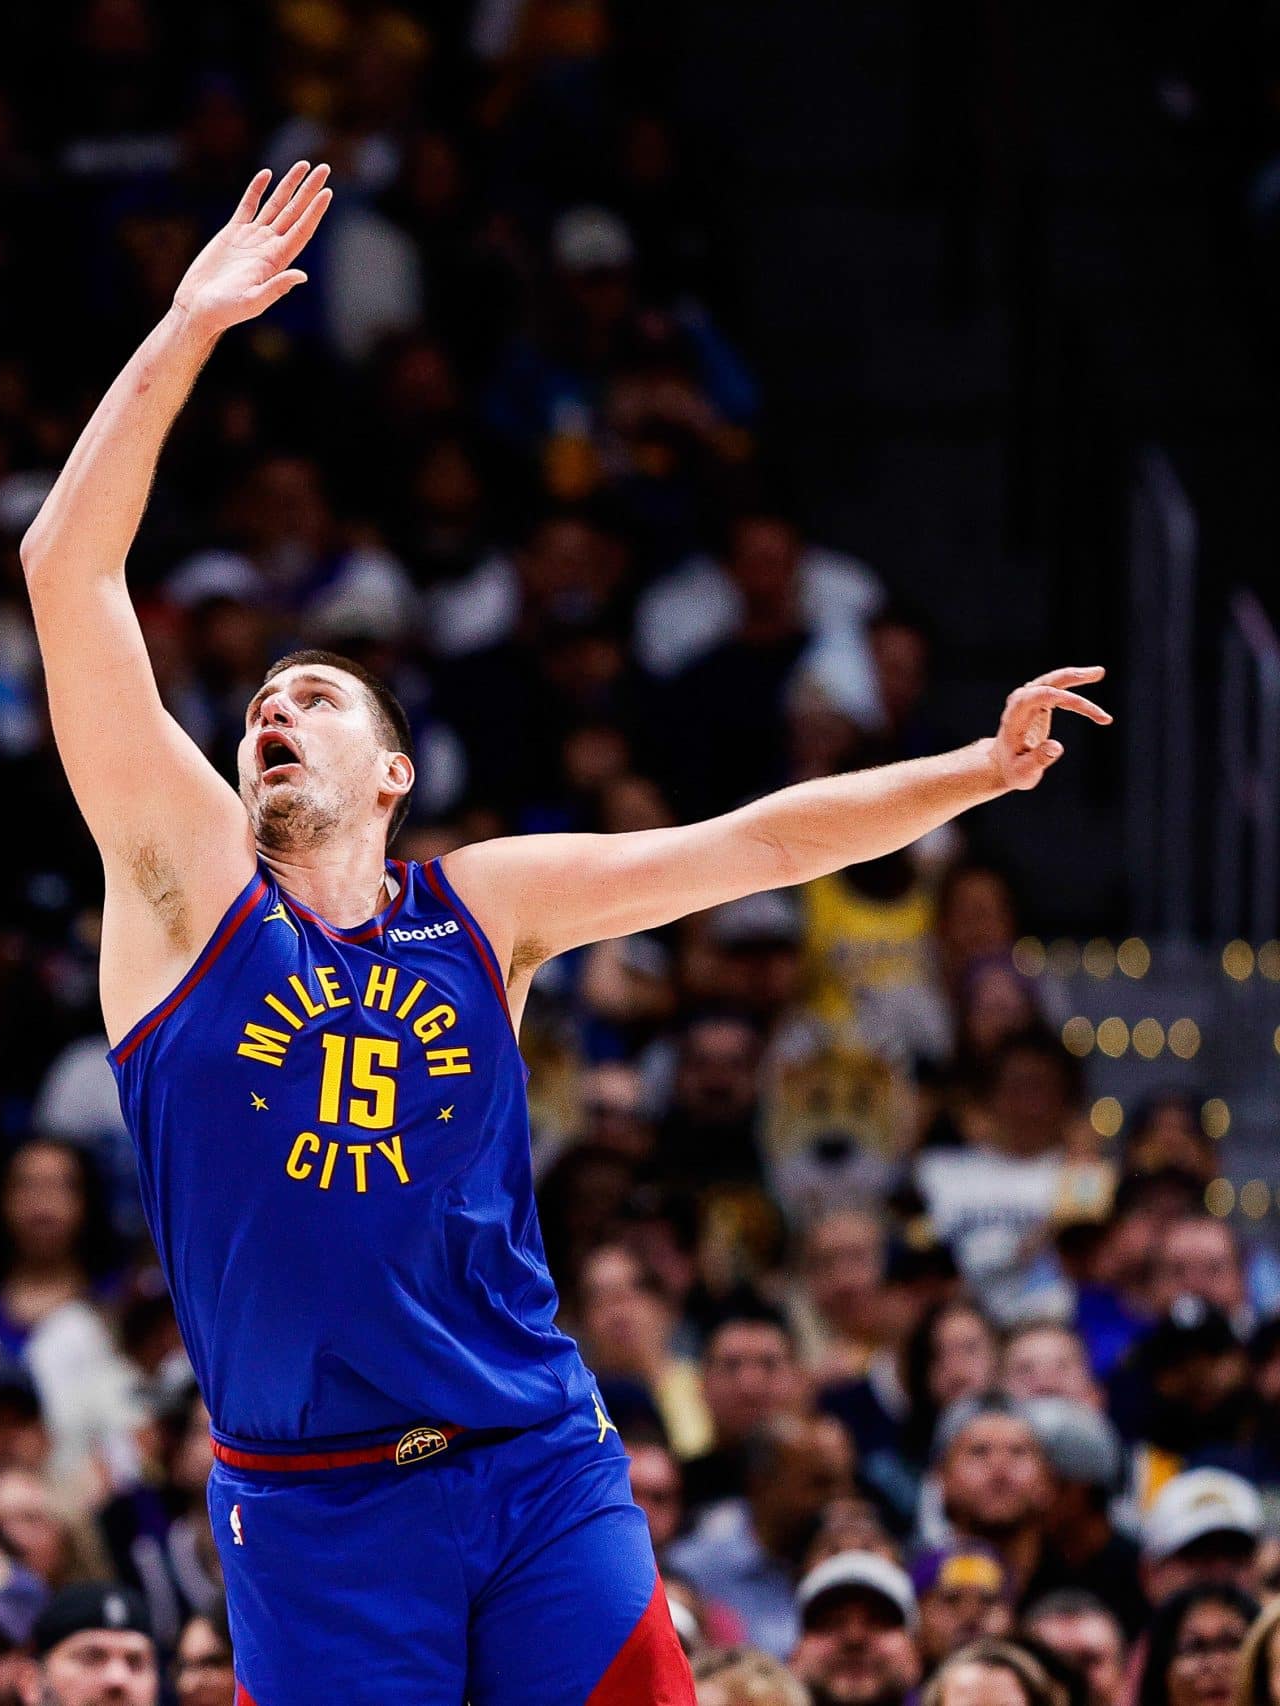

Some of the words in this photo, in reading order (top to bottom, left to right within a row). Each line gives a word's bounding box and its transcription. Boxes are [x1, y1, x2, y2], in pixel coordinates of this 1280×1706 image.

[387, 919, 460, 943] ibotta
[237, 966, 351, 1068] MILE
[363, 965, 472, 1077] HIGH
[318, 1033, 400, 1130] 15
[286, 1131, 410, 1193] CITY
